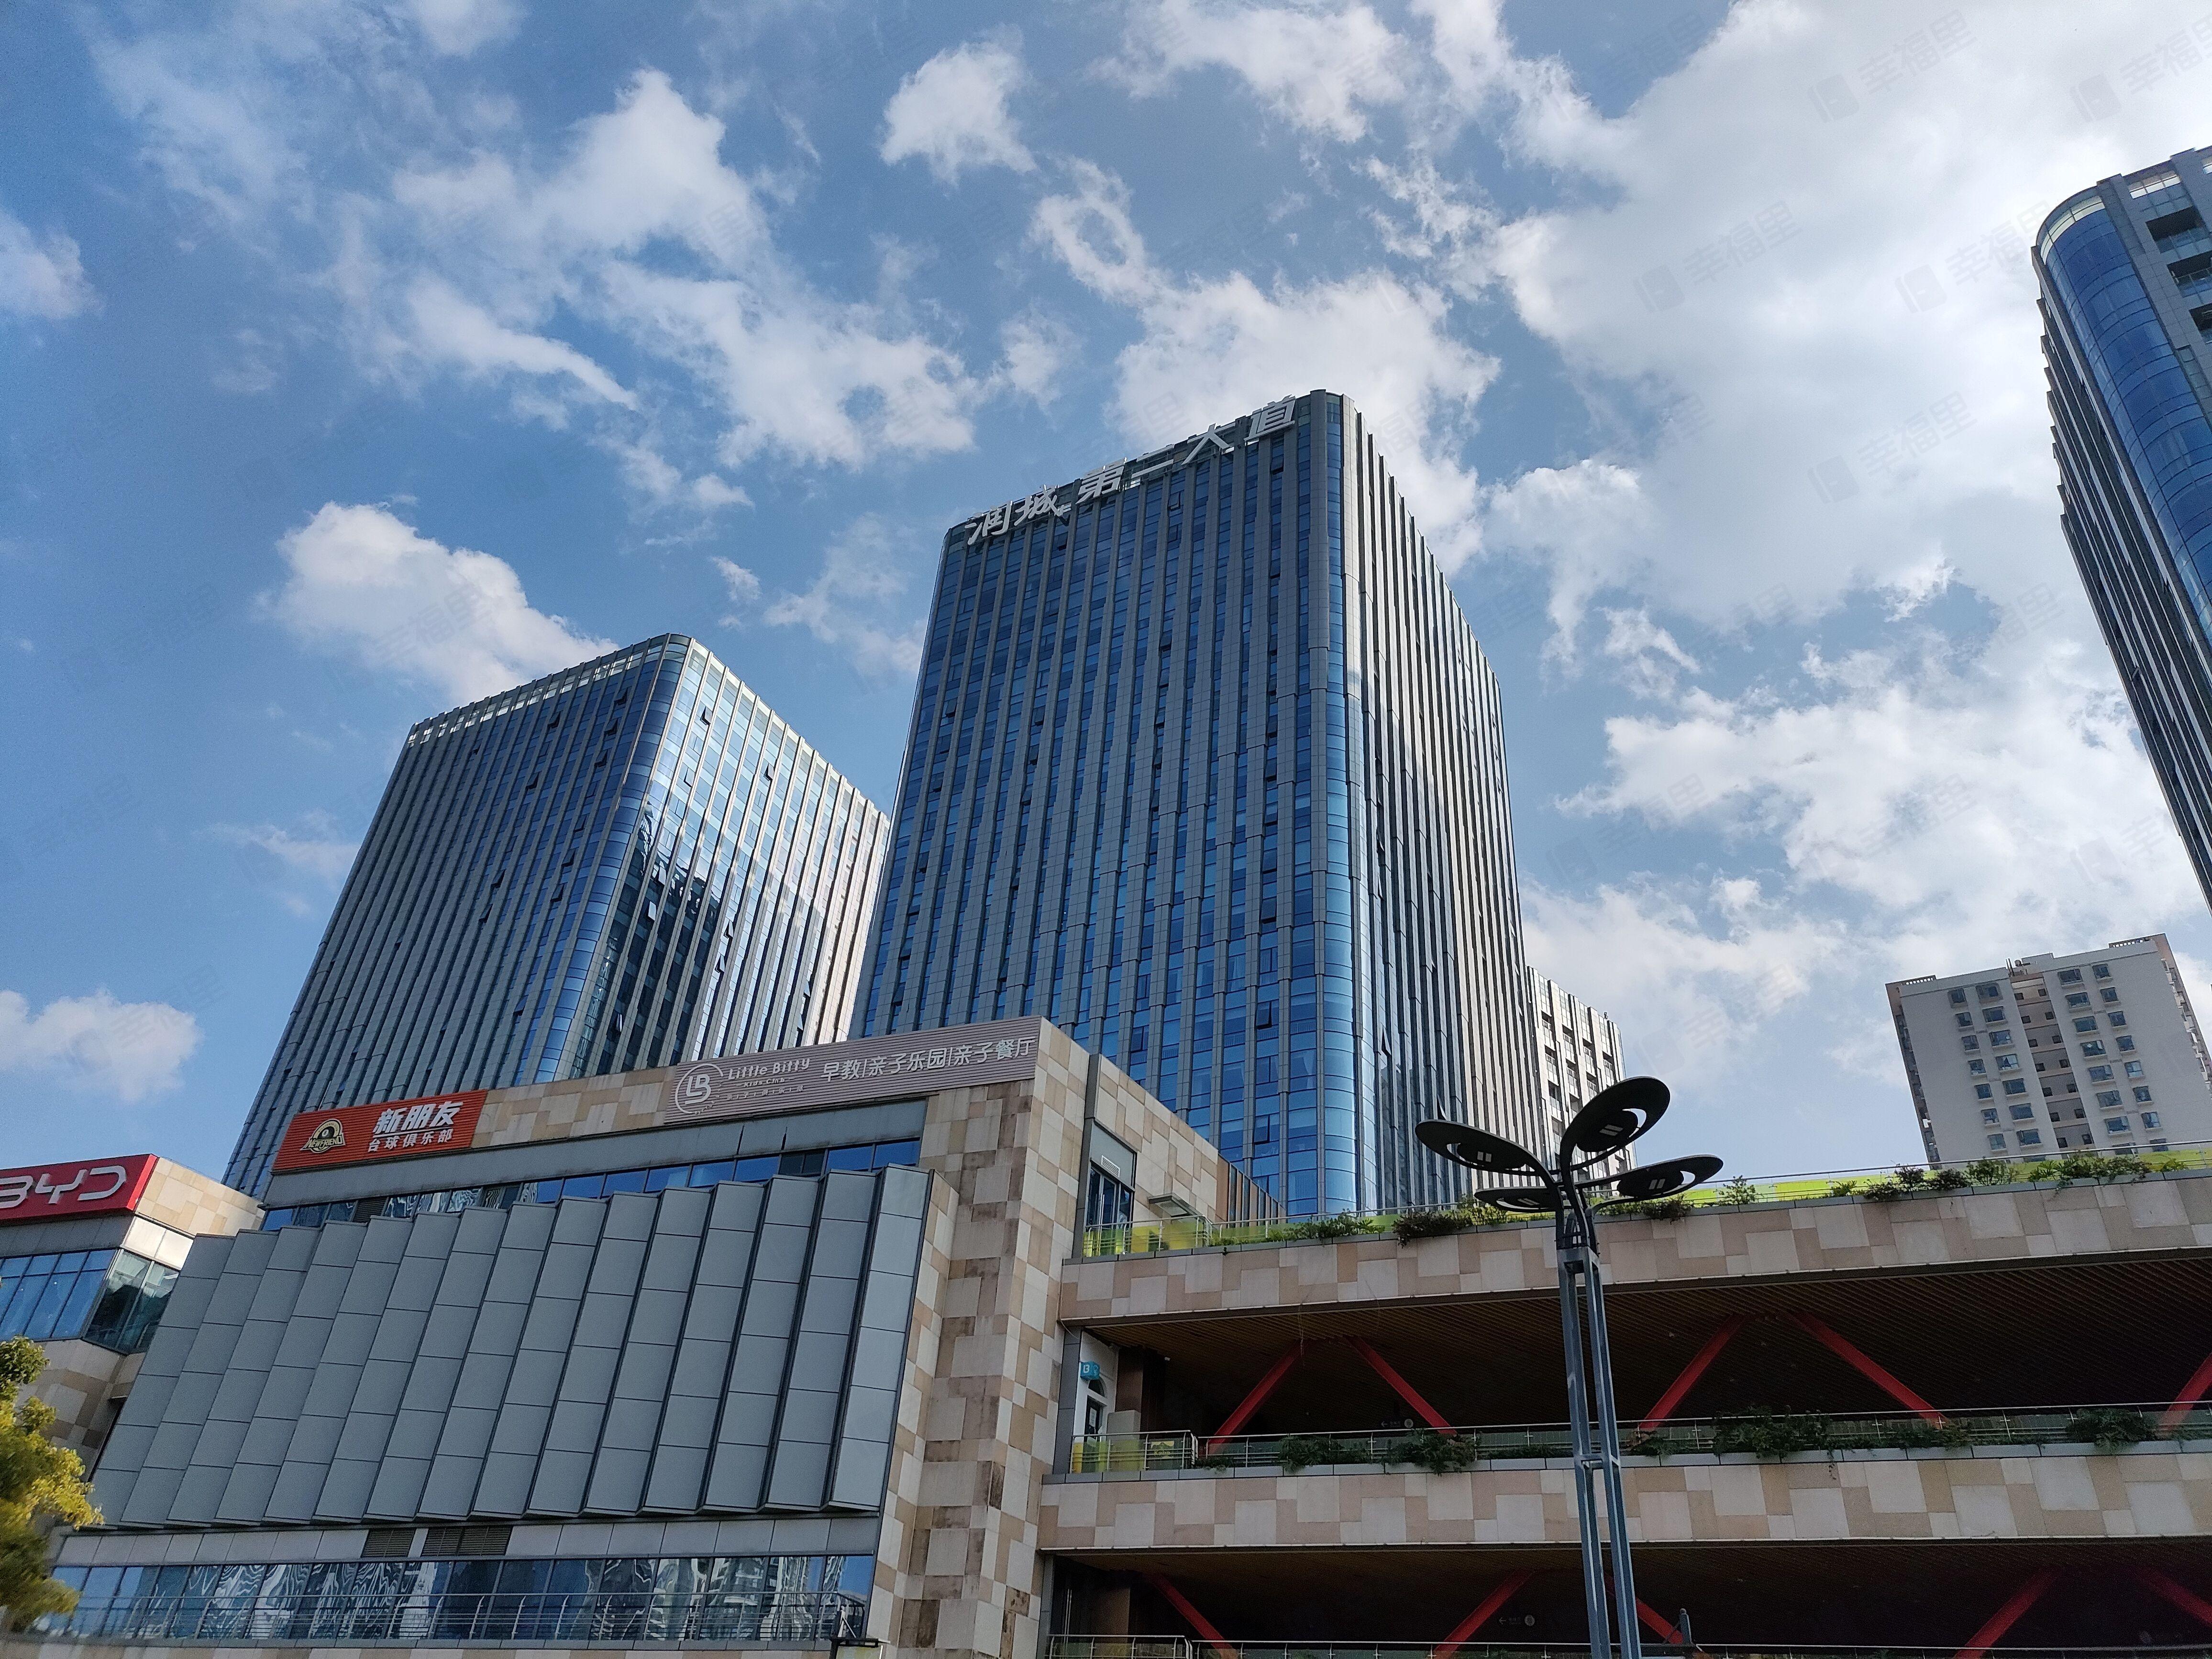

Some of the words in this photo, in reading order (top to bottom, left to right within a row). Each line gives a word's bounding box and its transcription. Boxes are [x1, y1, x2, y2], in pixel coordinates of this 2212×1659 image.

[728, 1065, 768, 1080] Little
[773, 1058, 810, 1074] Bitty
[372, 1101, 463, 1134] 新朋友
[367, 1128, 453, 1152] 台球俱乐部
[0, 1165, 127, 1209] BYD
